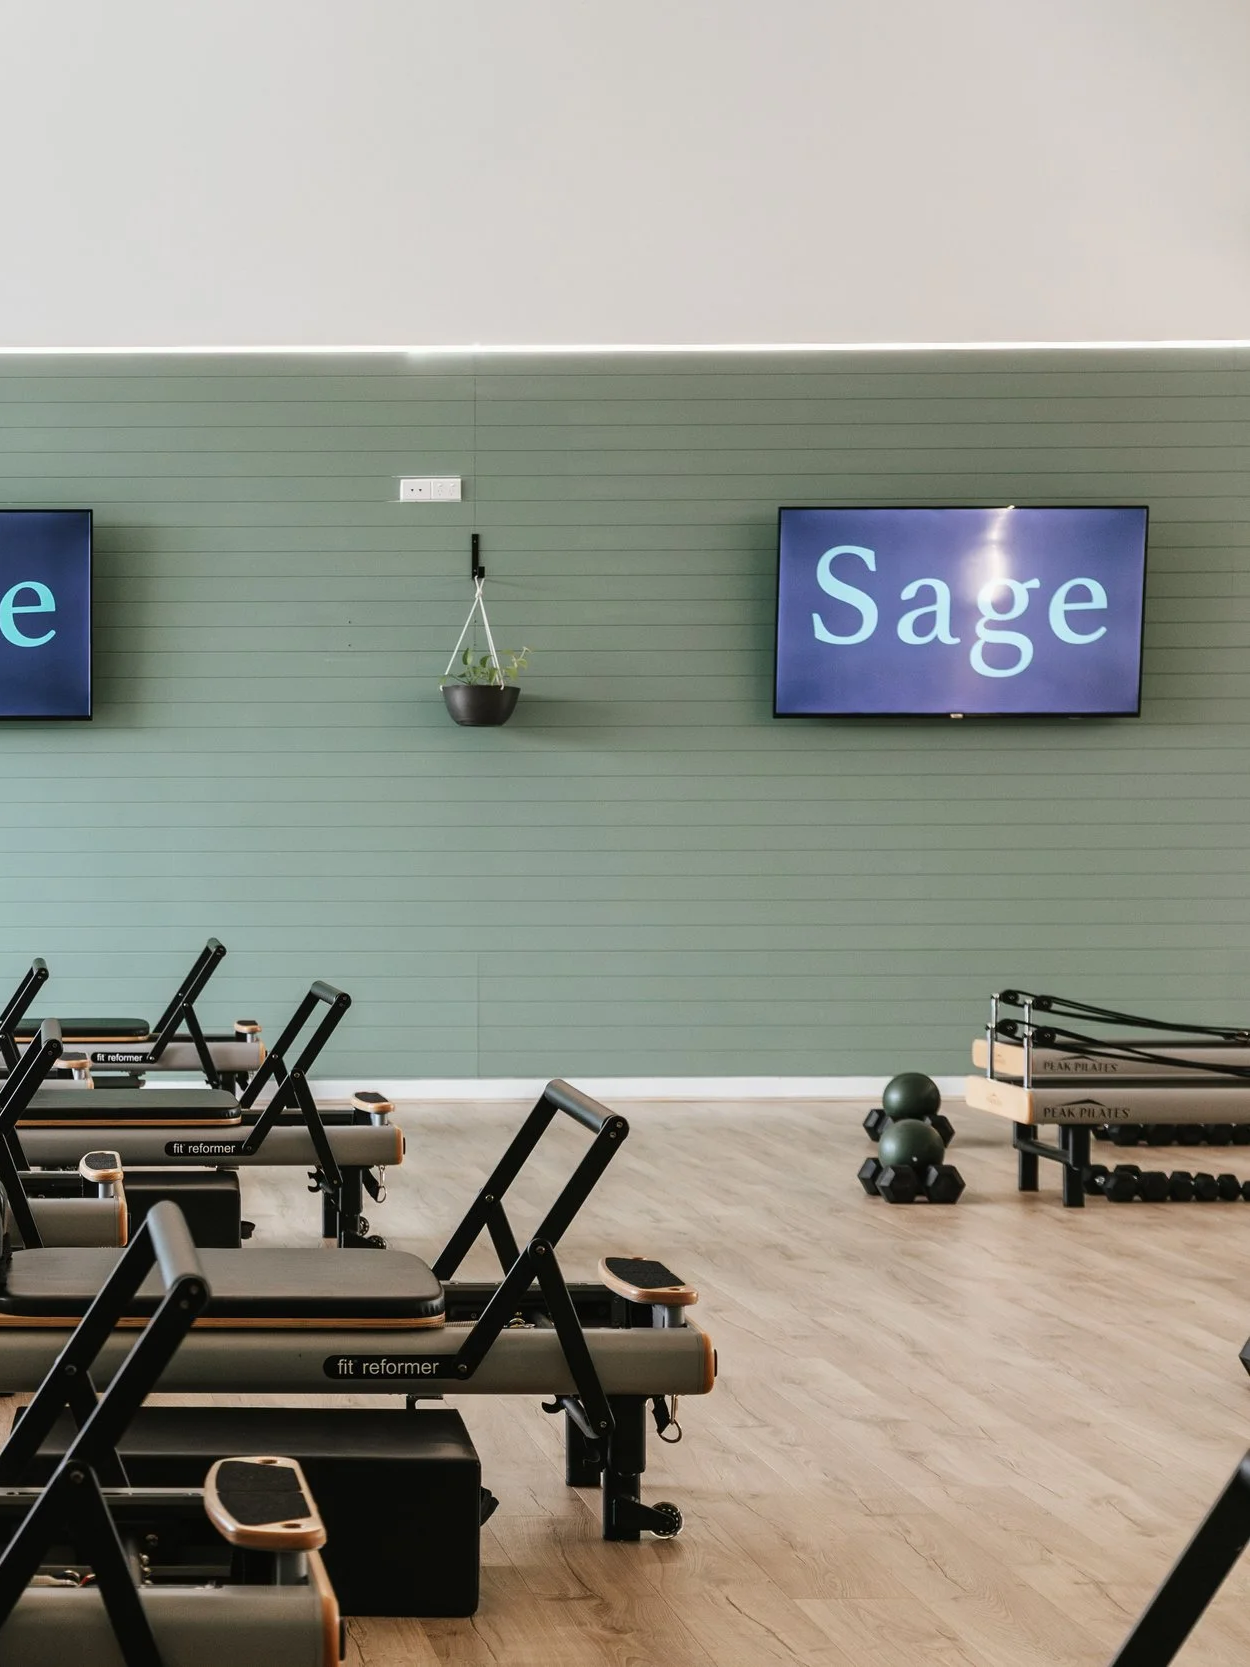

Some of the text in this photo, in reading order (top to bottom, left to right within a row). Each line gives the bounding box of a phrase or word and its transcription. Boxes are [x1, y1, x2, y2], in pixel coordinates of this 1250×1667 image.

[811, 545, 1108, 679] Sage
[96, 1053, 143, 1062] fit reformer
[1043, 1061, 1119, 1073] PEAK PILATES
[1043, 1107, 1130, 1119] PEAK PILATES
[173, 1143, 236, 1154] fit reformer
[337, 1358, 439, 1375] fit reformer
